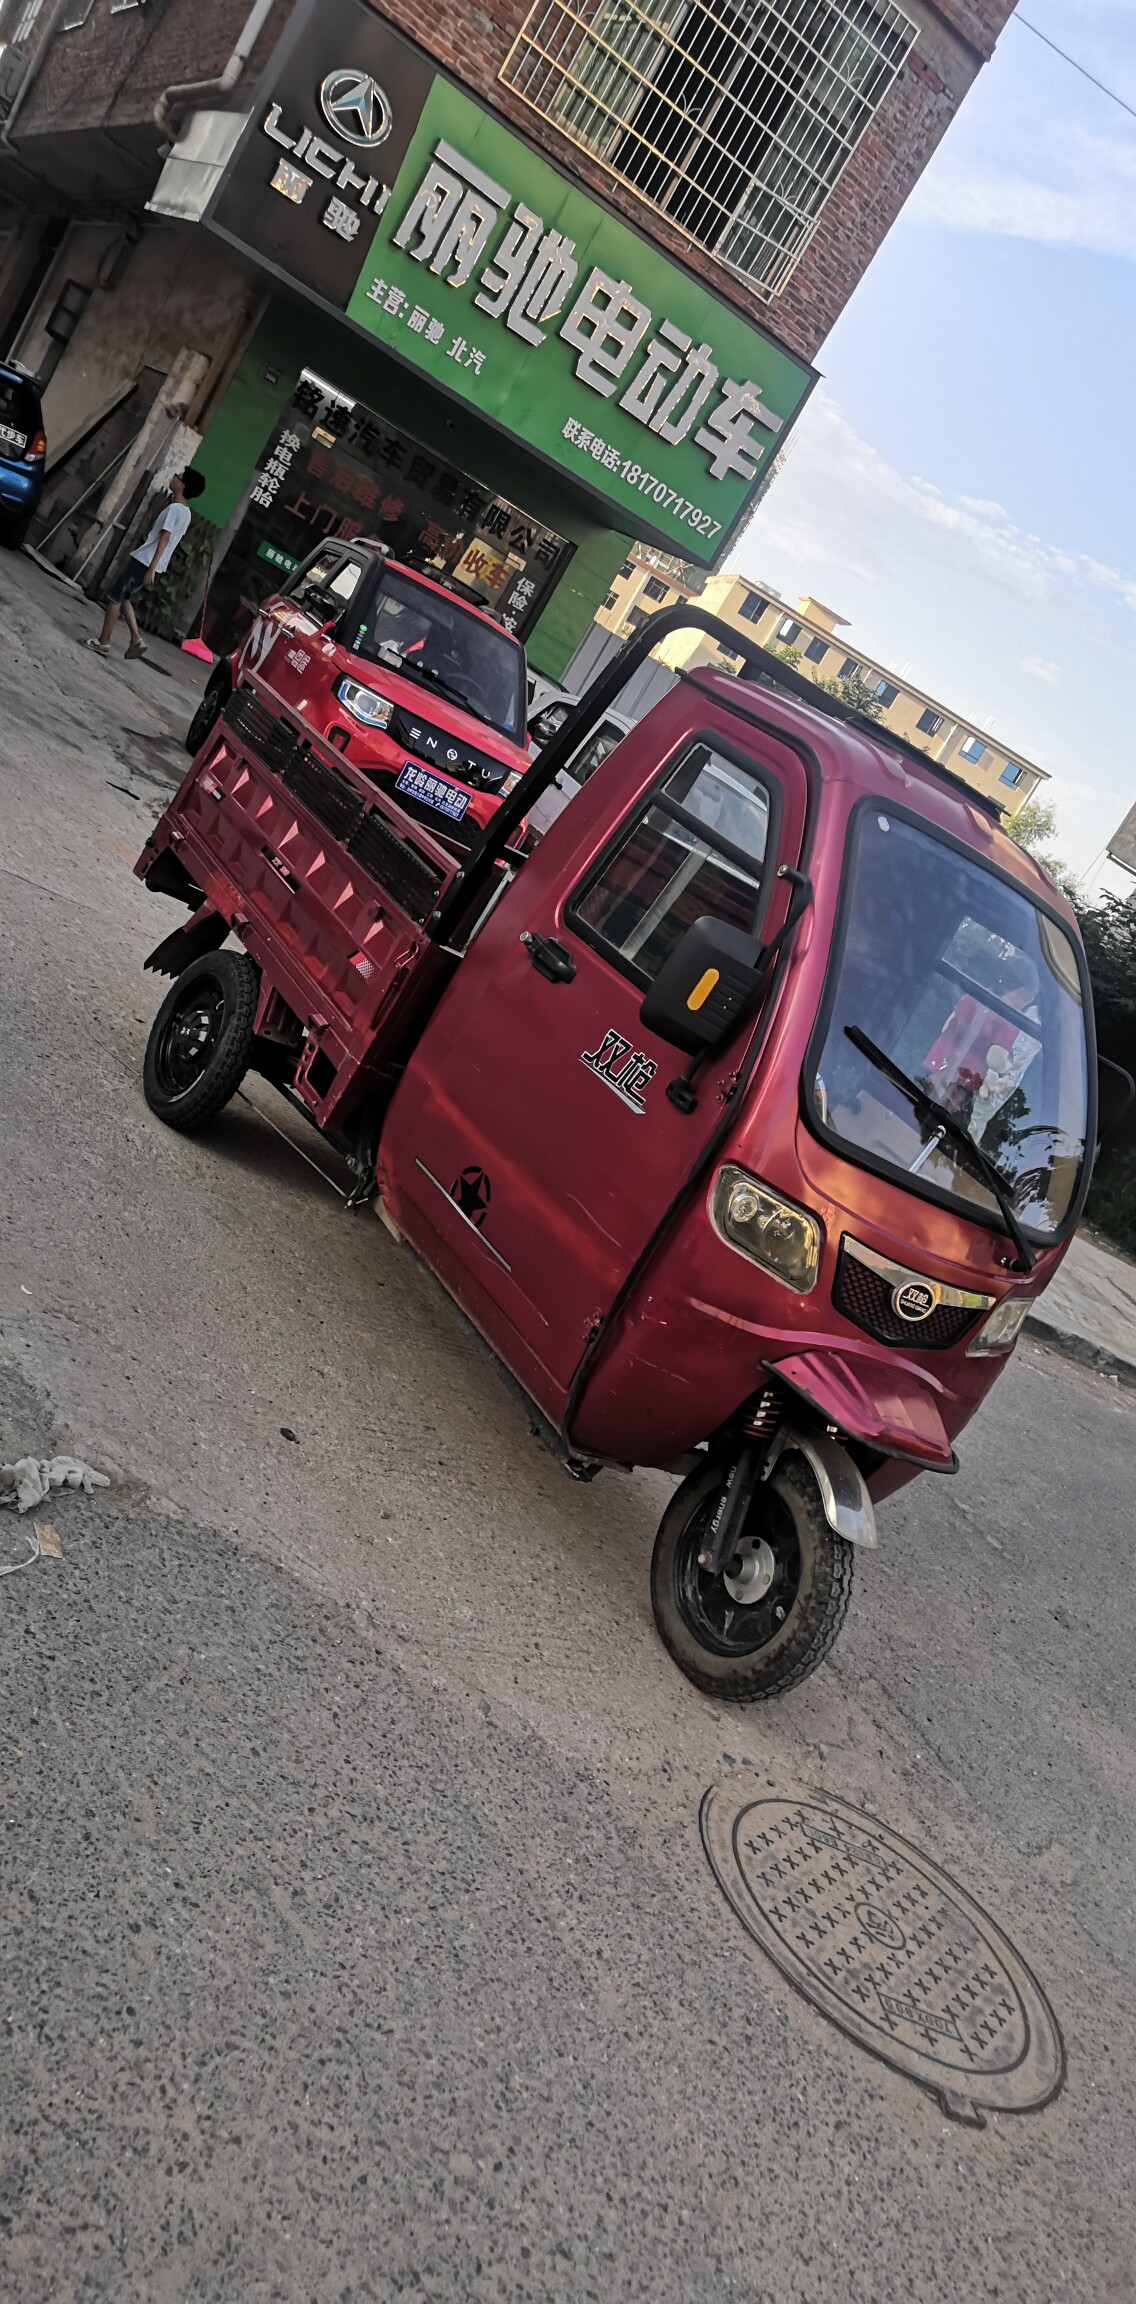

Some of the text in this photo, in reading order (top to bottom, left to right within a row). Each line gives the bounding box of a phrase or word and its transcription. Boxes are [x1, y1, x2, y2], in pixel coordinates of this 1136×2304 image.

[392, 137, 785, 482] 丽驰电动车
[446, 336, 487, 376] 北汽
[249, 429, 301, 509] 换电瓶轮胎
[292, 379, 562, 572] 铭速汽车贸易有限公司
[306, 448, 405, 522] 售后维修
[561, 416, 723, 540] 联系电话:18170717927
[417, 519, 511, 590] 高价收车
[580, 1028, 659, 1106] 双枪
[709, 1465, 738, 1535] new energy
